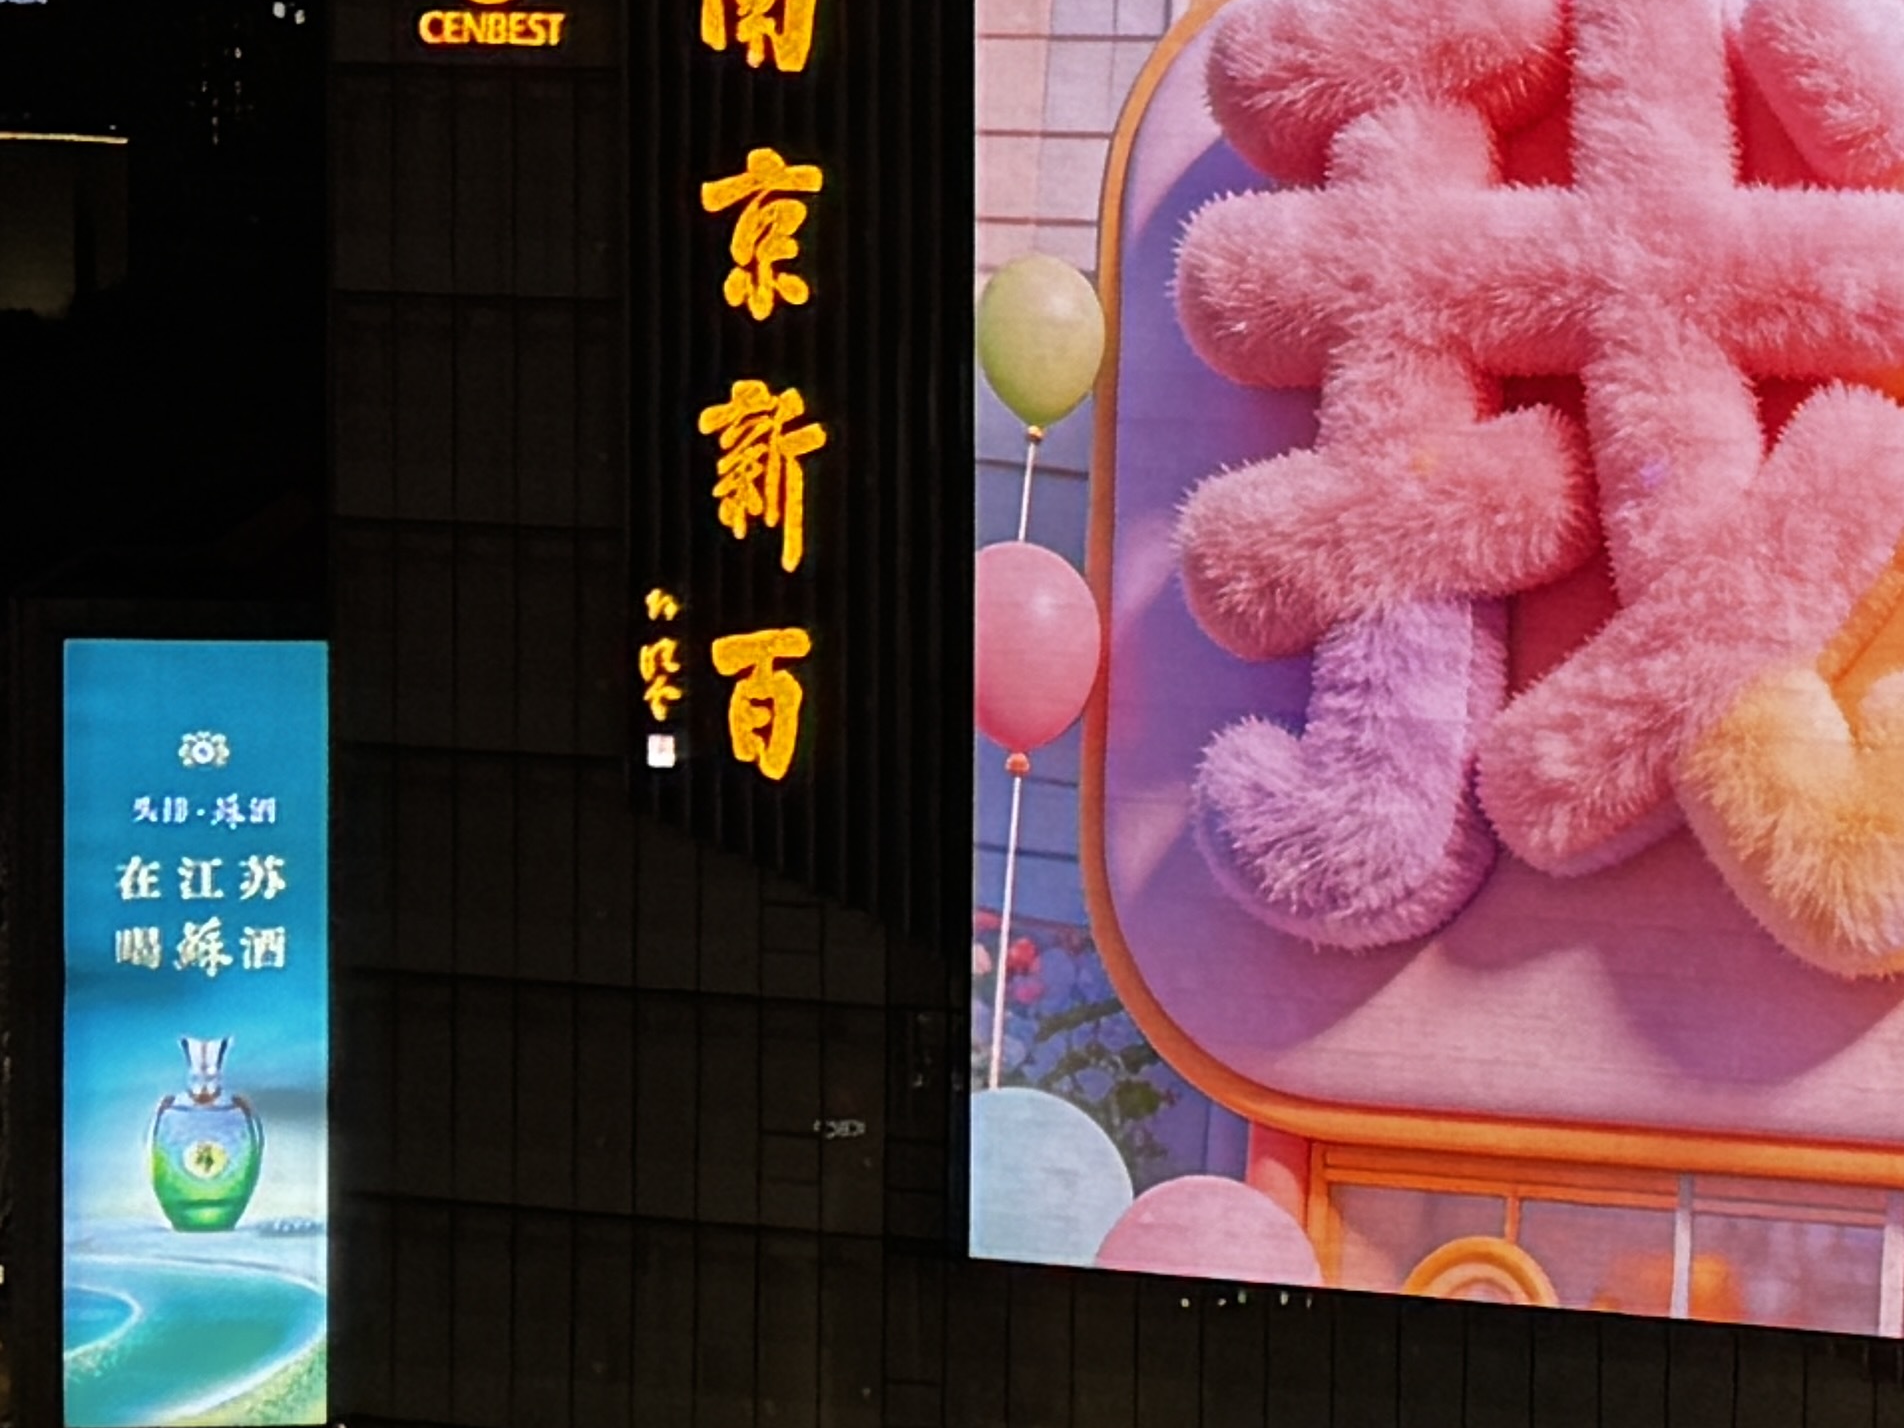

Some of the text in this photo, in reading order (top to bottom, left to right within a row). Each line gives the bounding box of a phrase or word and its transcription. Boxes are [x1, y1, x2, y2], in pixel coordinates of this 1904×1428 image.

[418, 9, 566, 47] CENBEST
[115, 854, 287, 901] 在江苏
